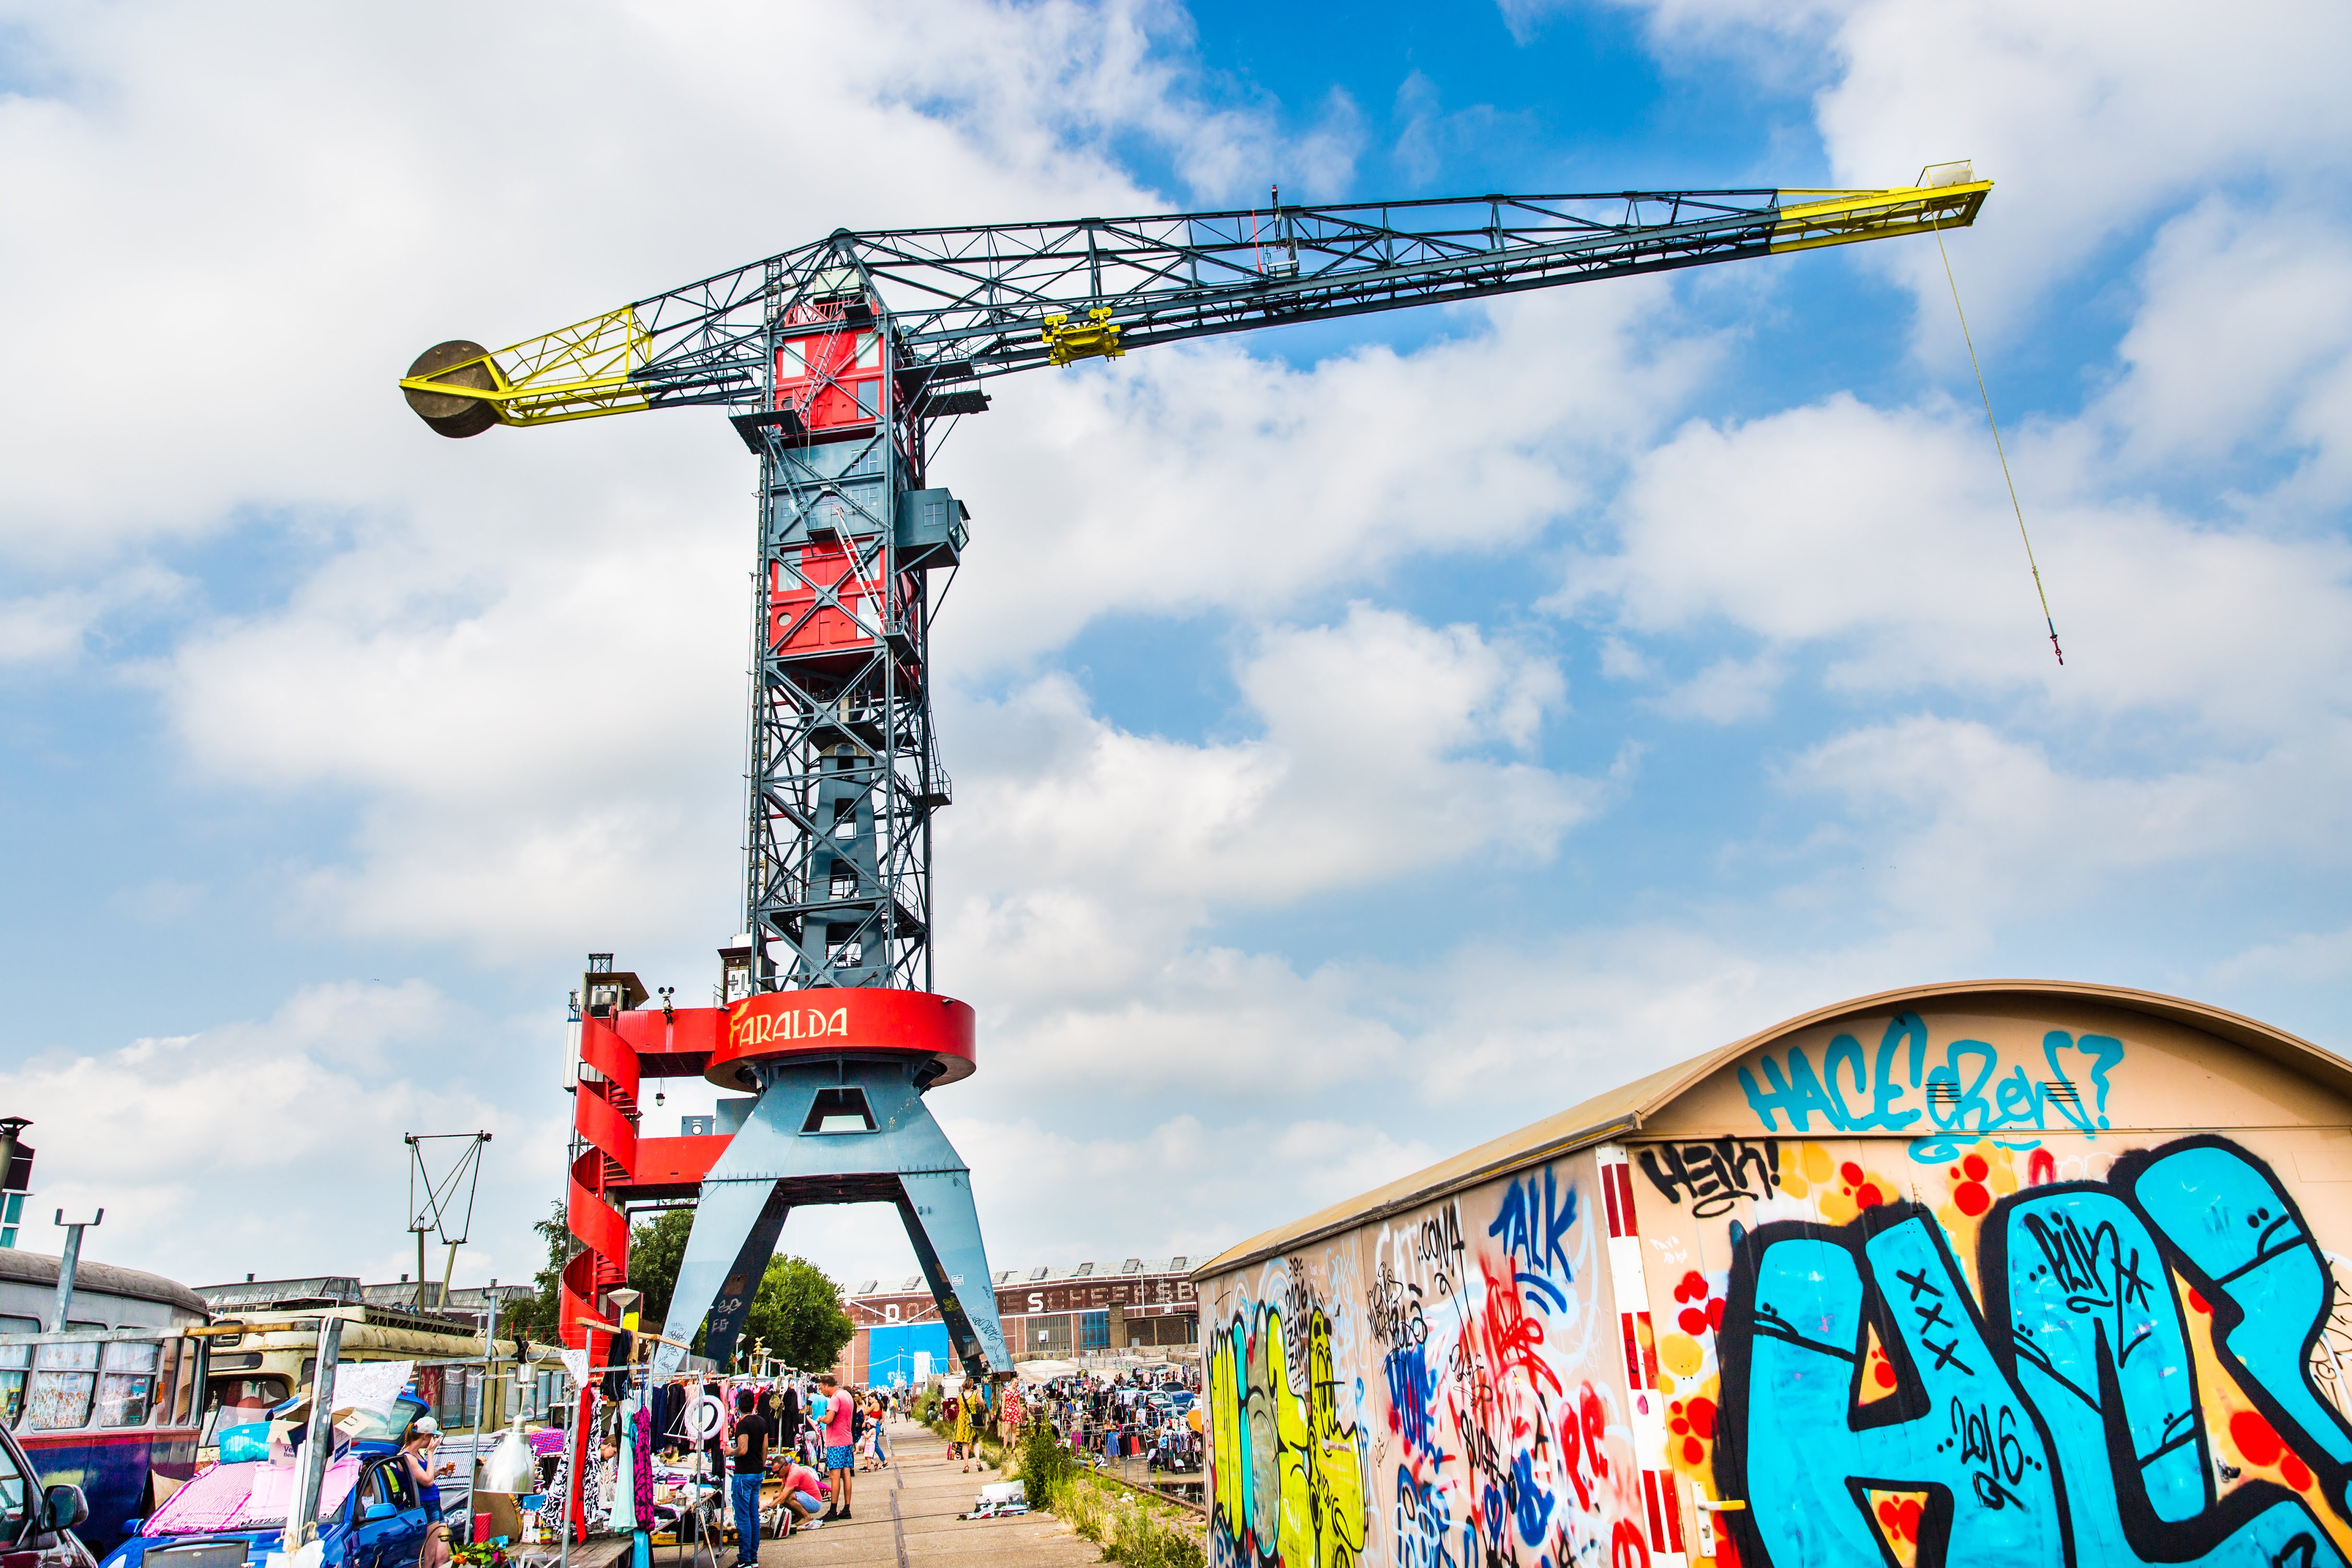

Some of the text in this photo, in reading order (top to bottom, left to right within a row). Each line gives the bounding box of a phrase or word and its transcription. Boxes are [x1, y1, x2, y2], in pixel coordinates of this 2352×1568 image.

[729, 1001, 848, 1049] FARALDA
[1489, 1164, 1577, 1282] TALK
[1950, 1395, 2024, 1486] 2016
